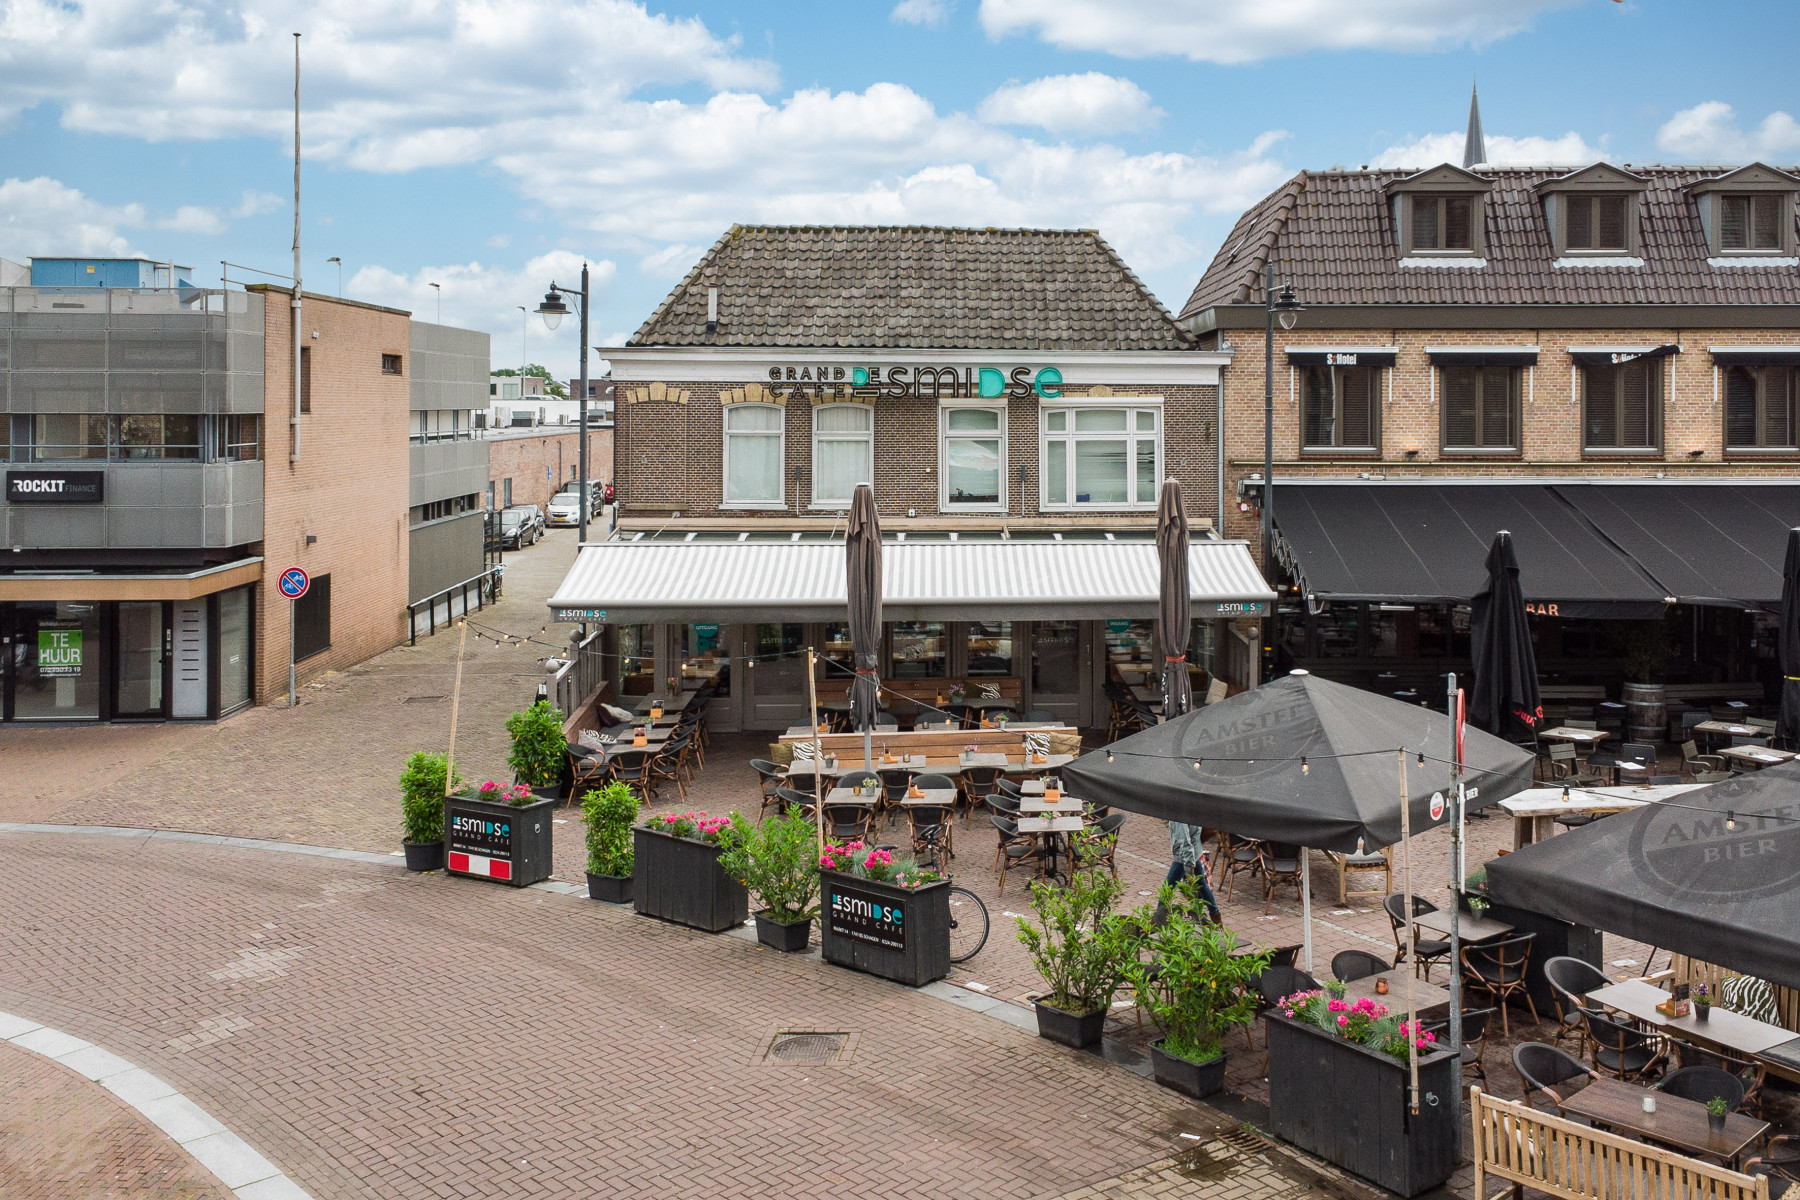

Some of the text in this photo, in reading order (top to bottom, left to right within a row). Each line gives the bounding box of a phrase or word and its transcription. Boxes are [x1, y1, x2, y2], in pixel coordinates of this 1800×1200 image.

[769, 366, 846, 381] GRAND
[768, 382, 846, 398] CAFE
[12, 479, 96, 493] ROCKIT FINANCE
[51, 632, 69, 647] TE
[40, 648, 81, 663] HUUR
[1225, 735, 1276, 755] BIER
[1661, 803, 1800, 845] AMSTE
[453, 831, 481, 840] GRAND
[1704, 839, 1779, 863] BIER
[832, 910, 903, 935] GRAND CAFE
